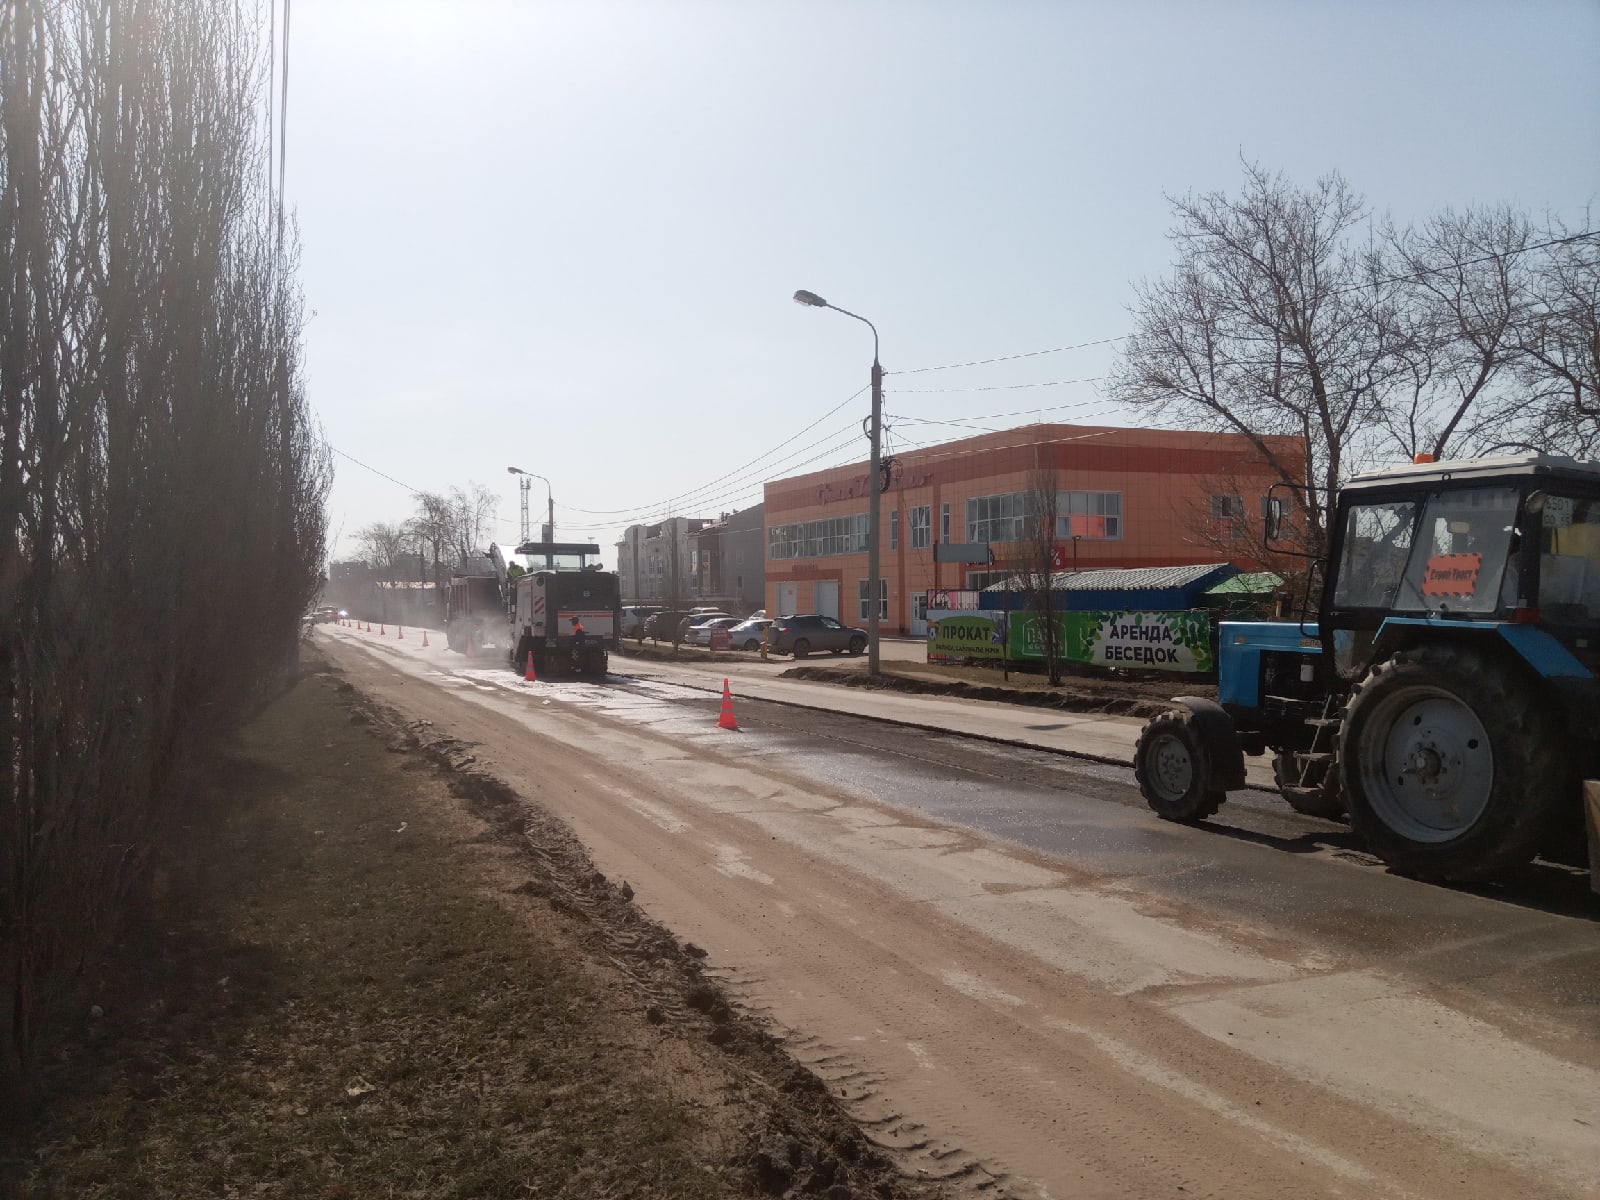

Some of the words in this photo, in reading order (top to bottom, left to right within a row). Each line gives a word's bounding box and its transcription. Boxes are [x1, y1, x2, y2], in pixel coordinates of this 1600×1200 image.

[943, 626, 990, 641] ПРОКАТ
[1109, 625, 1173, 643] АРЕНДА
[1105, 645, 1180, 665] БЕСЕДОК
